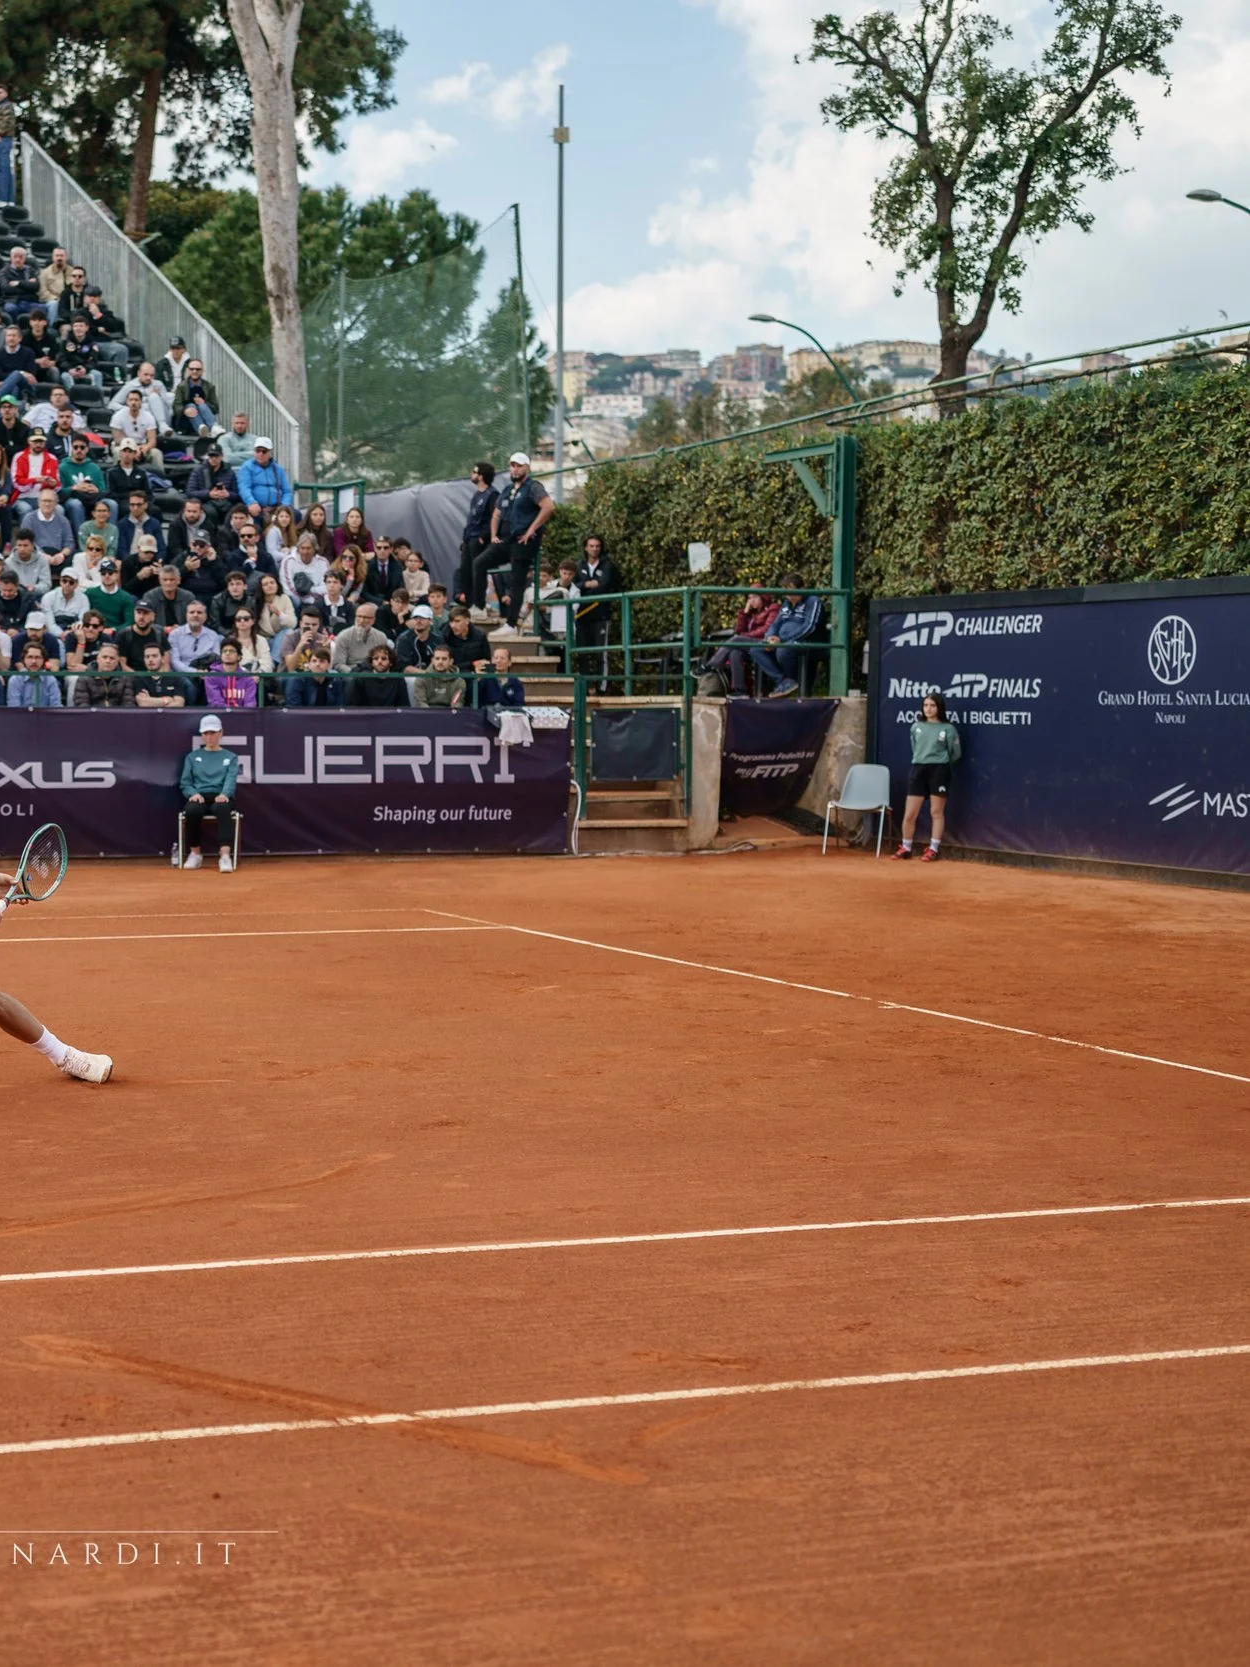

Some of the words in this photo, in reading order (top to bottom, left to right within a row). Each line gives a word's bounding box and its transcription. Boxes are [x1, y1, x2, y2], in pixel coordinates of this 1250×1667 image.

[890, 611, 954, 647] ATP
[955, 615, 1043, 636] CHALLENGER
[888, 678, 941, 698] Nitto
[942, 673, 988, 698] ATP
[988, 678, 1041, 698] FINALS
[969, 711, 1032, 726] BIGLIETTI
[373, 805, 437, 825] Shaping
[439, 809, 466, 821] our
[468, 805, 513, 821] future
[1203, 792, 1250, 818] MAS
